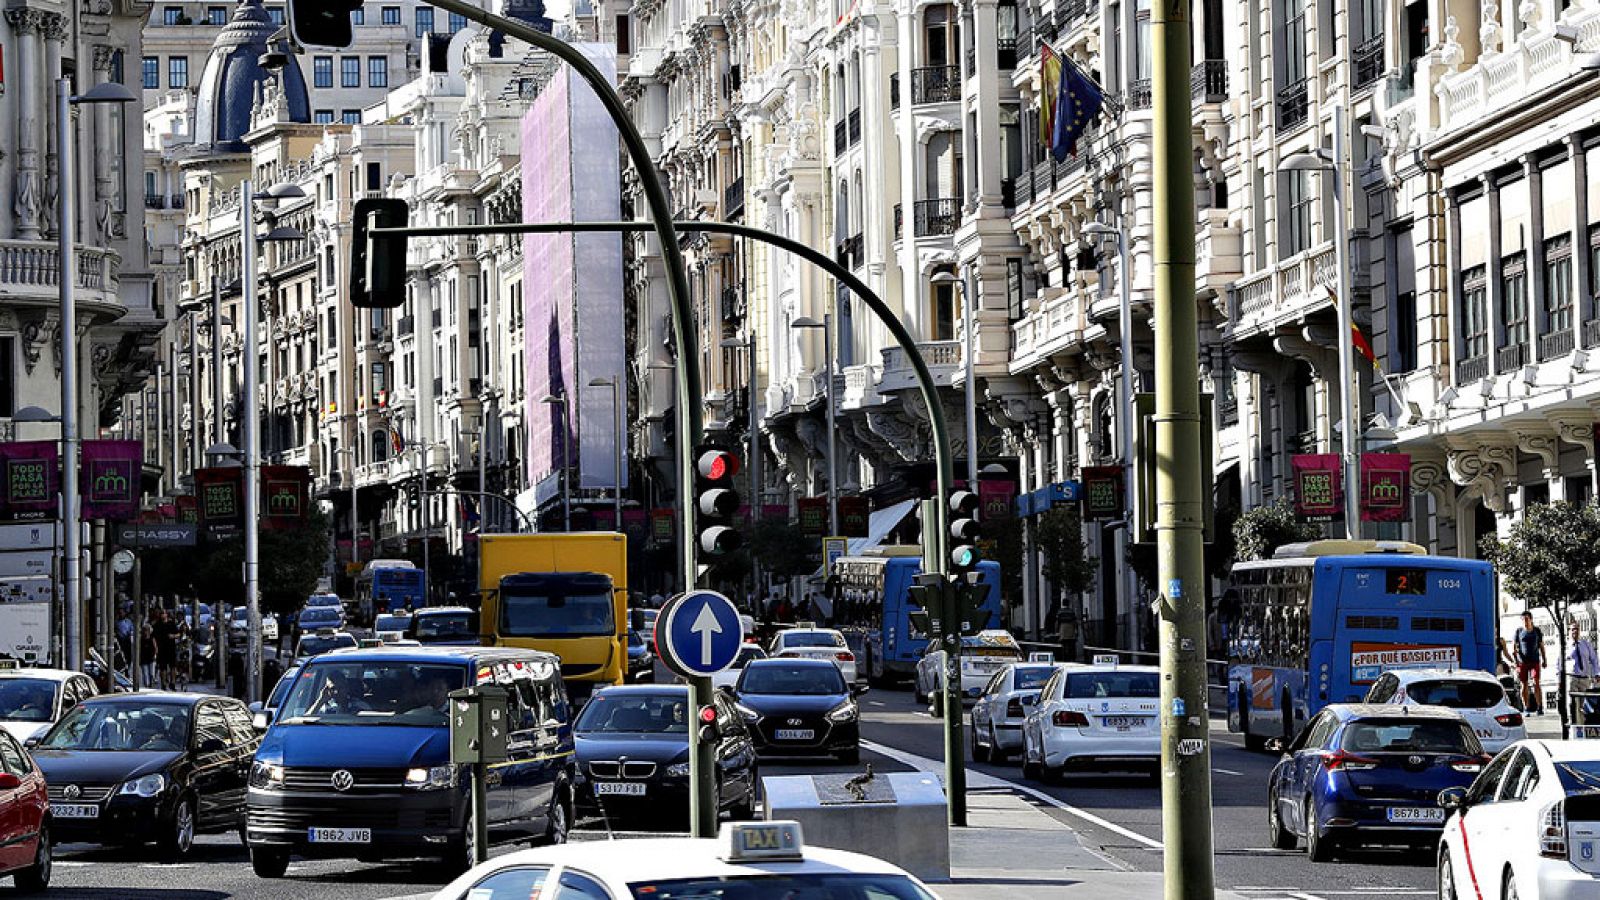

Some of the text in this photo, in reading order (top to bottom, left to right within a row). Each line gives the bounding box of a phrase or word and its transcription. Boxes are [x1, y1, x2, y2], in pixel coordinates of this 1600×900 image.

[12, 465, 43, 473] TODO
[12, 474, 43, 482] PASA
[1304, 475, 1329, 483] TODO
[1304, 483, 1329, 491] PASA
[122, 530, 190, 540] GRASSY
[1397, 576, 1407, 589] 2
[1438, 579, 1461, 589] 1034
[1354, 653, 1379, 666] ¿POR
[1381, 651, 1399, 663] QUÉ
[317, 830, 370, 841] 1962 JVB
[743, 828, 779, 849] TAXI
